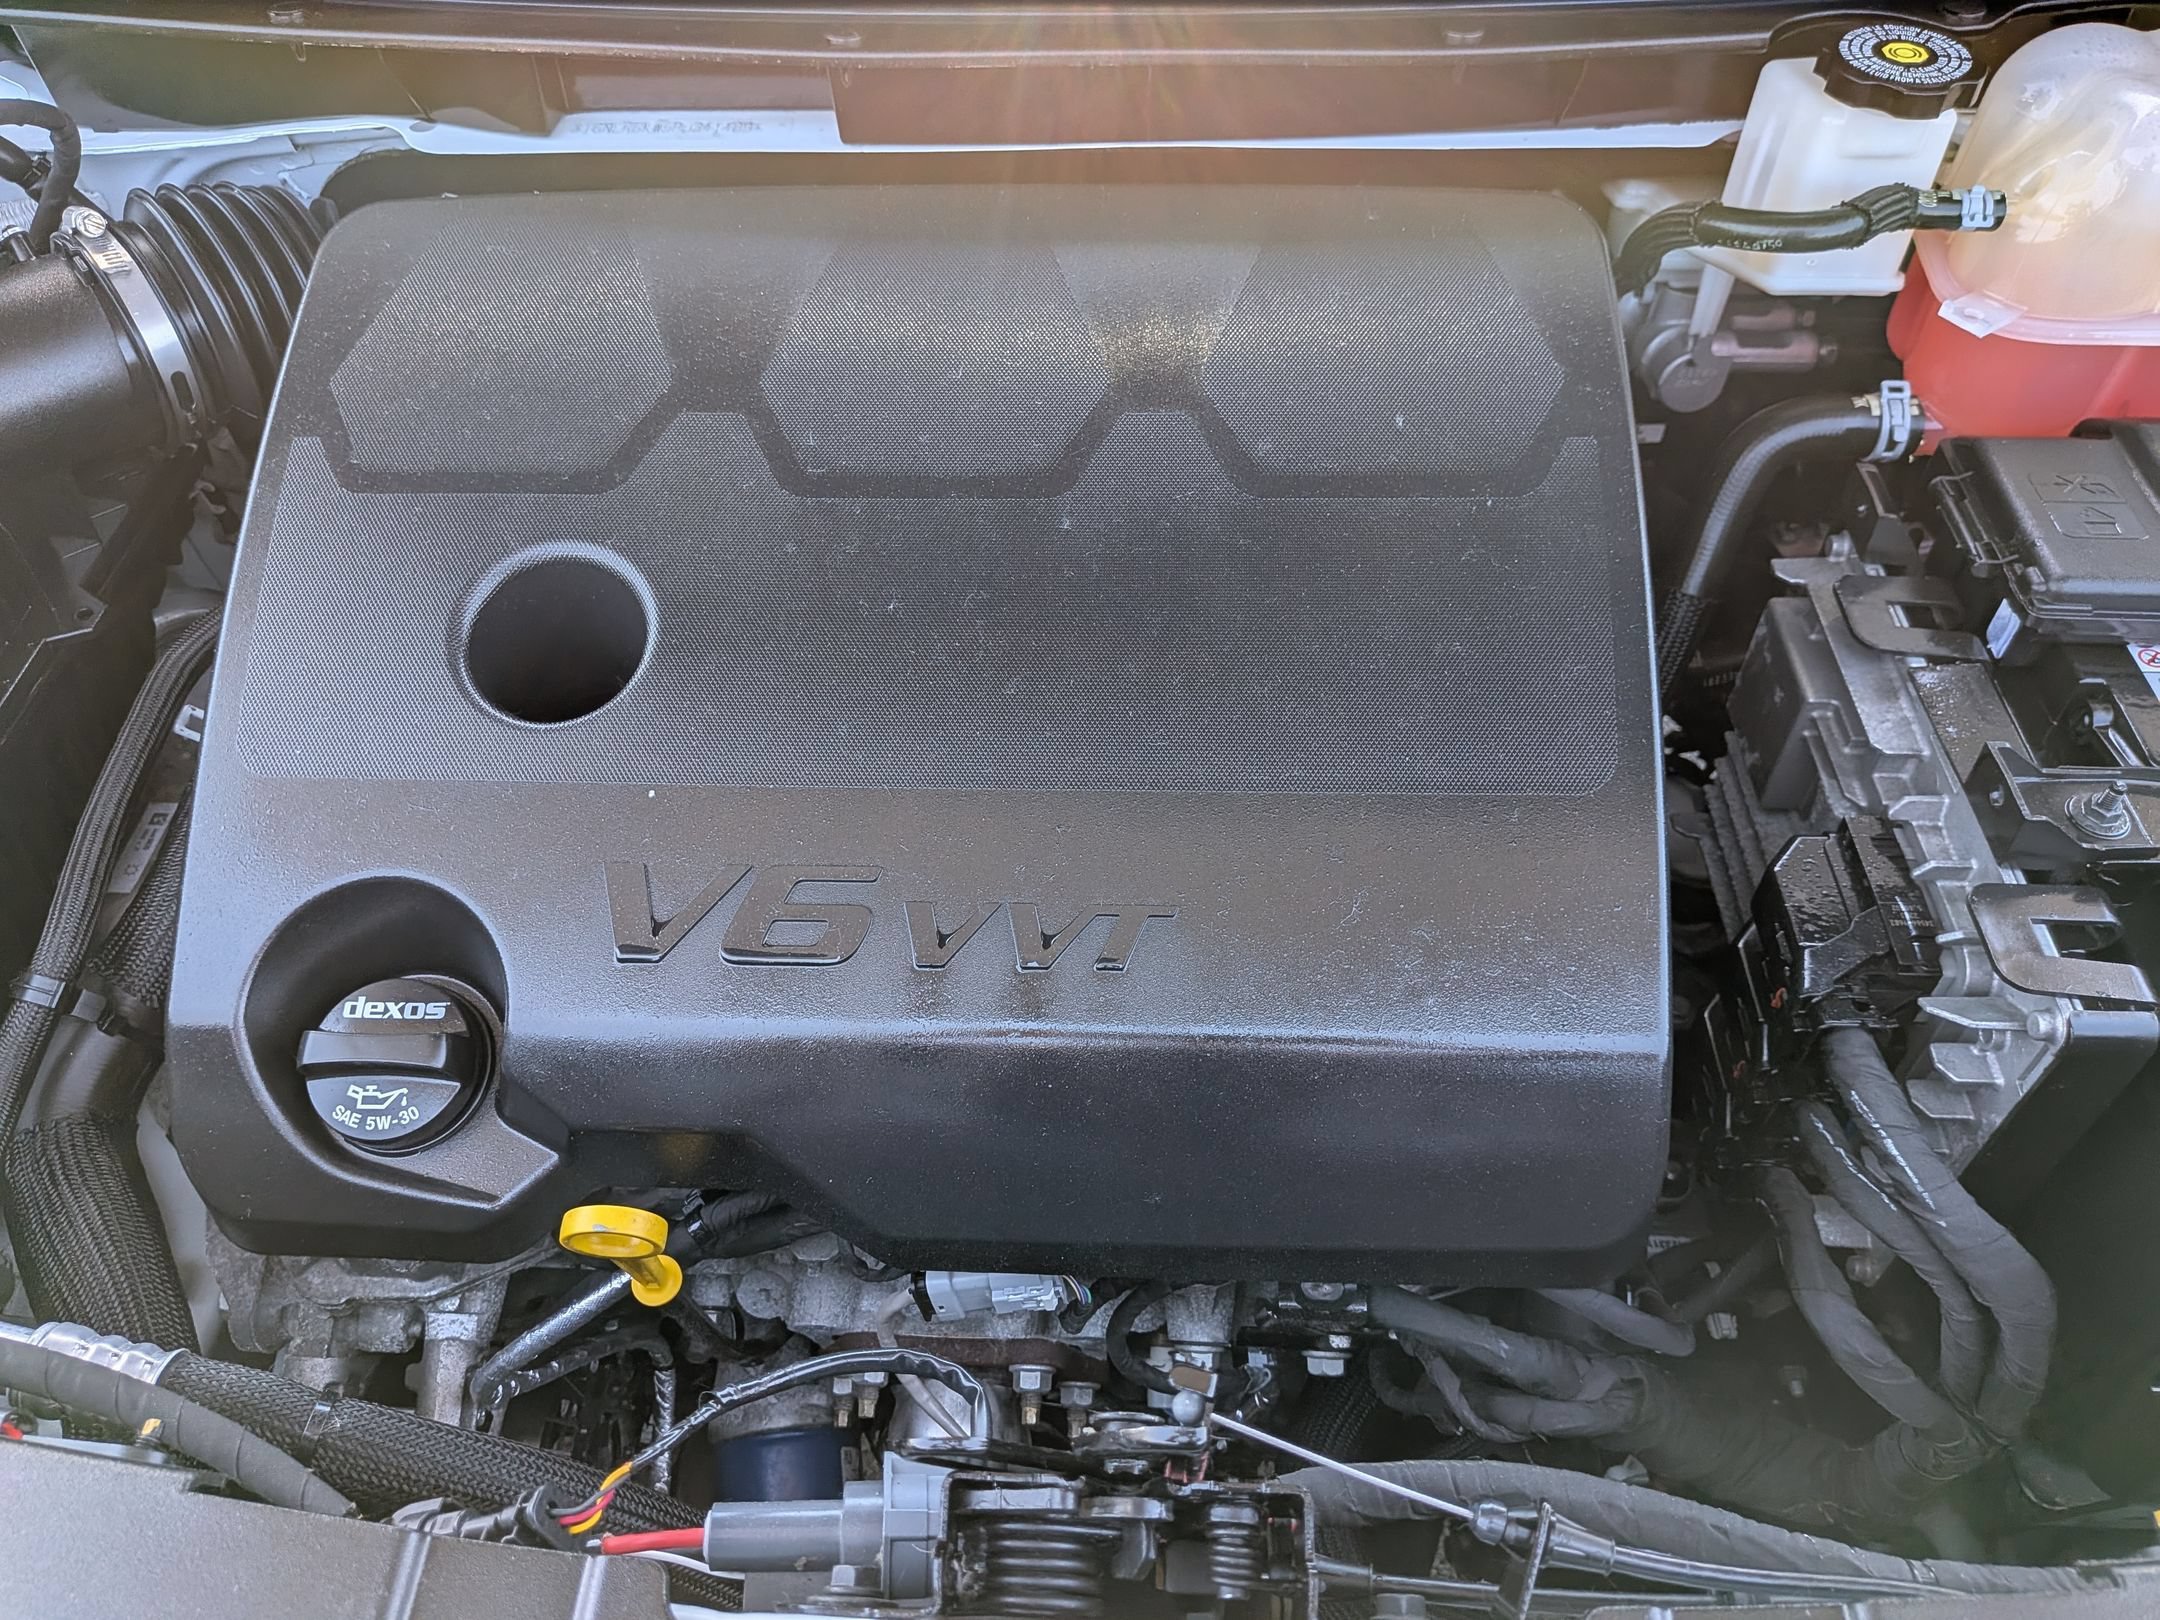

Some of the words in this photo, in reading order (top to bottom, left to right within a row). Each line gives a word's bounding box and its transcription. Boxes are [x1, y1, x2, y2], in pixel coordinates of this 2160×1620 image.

[1883, 24, 1921, 33] BOUCHON
[1889, 74, 1914, 83] FROM
[603, 863, 882, 966] V6
[904, 901, 1179, 972] VVT
[343, 996, 449, 1019] dexos
[332, 1105, 362, 1128] SAE
[365, 1106, 419, 1130] 5W-30
